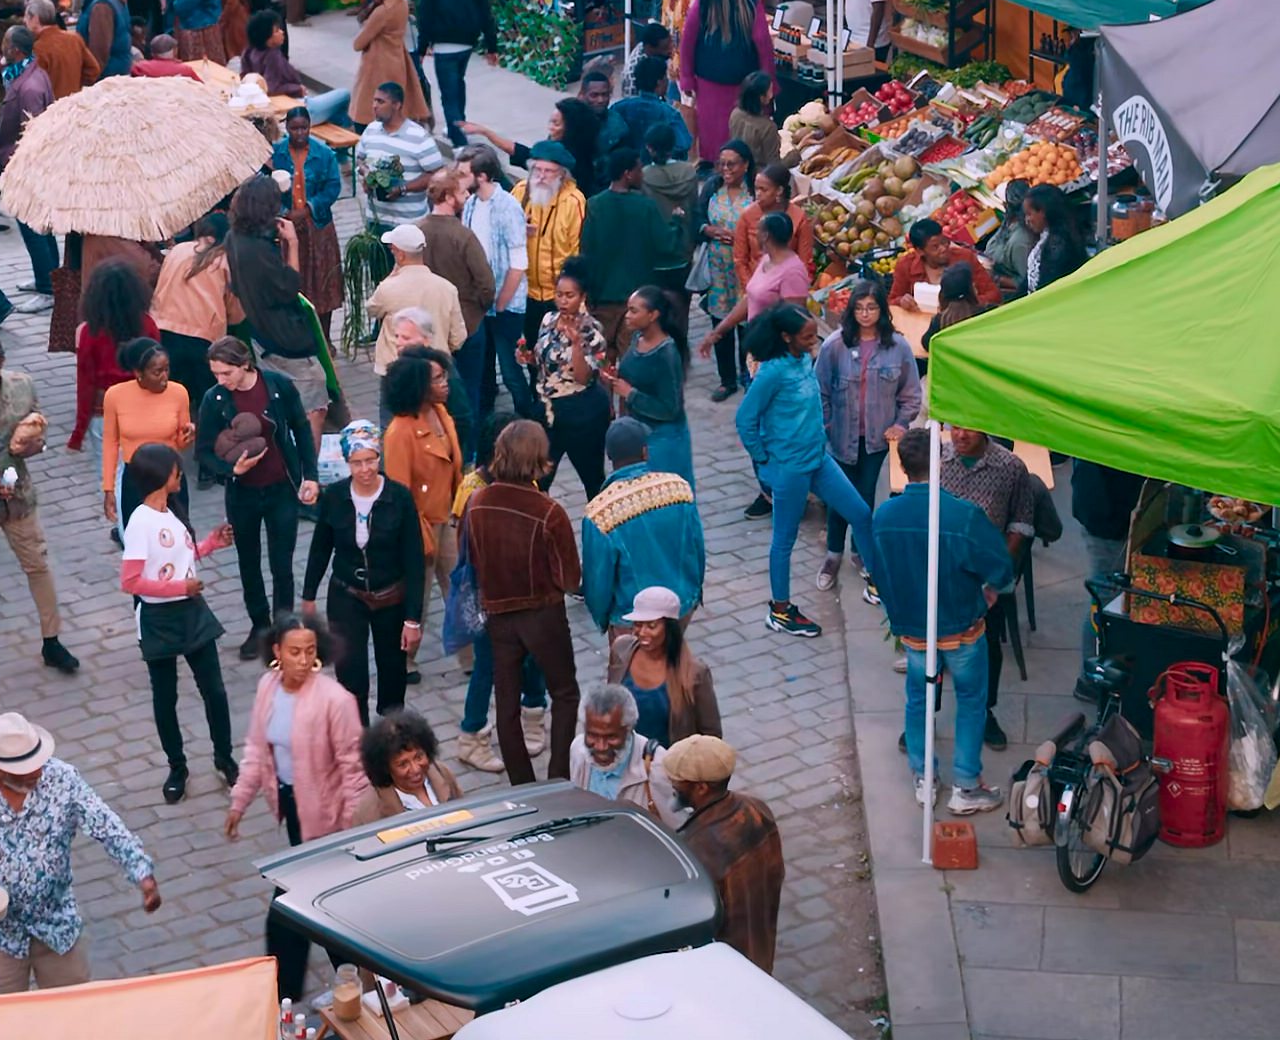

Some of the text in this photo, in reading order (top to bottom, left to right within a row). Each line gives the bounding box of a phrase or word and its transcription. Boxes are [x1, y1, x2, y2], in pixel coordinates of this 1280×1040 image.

[1118, 103, 1170, 201] THE RIB MAN
